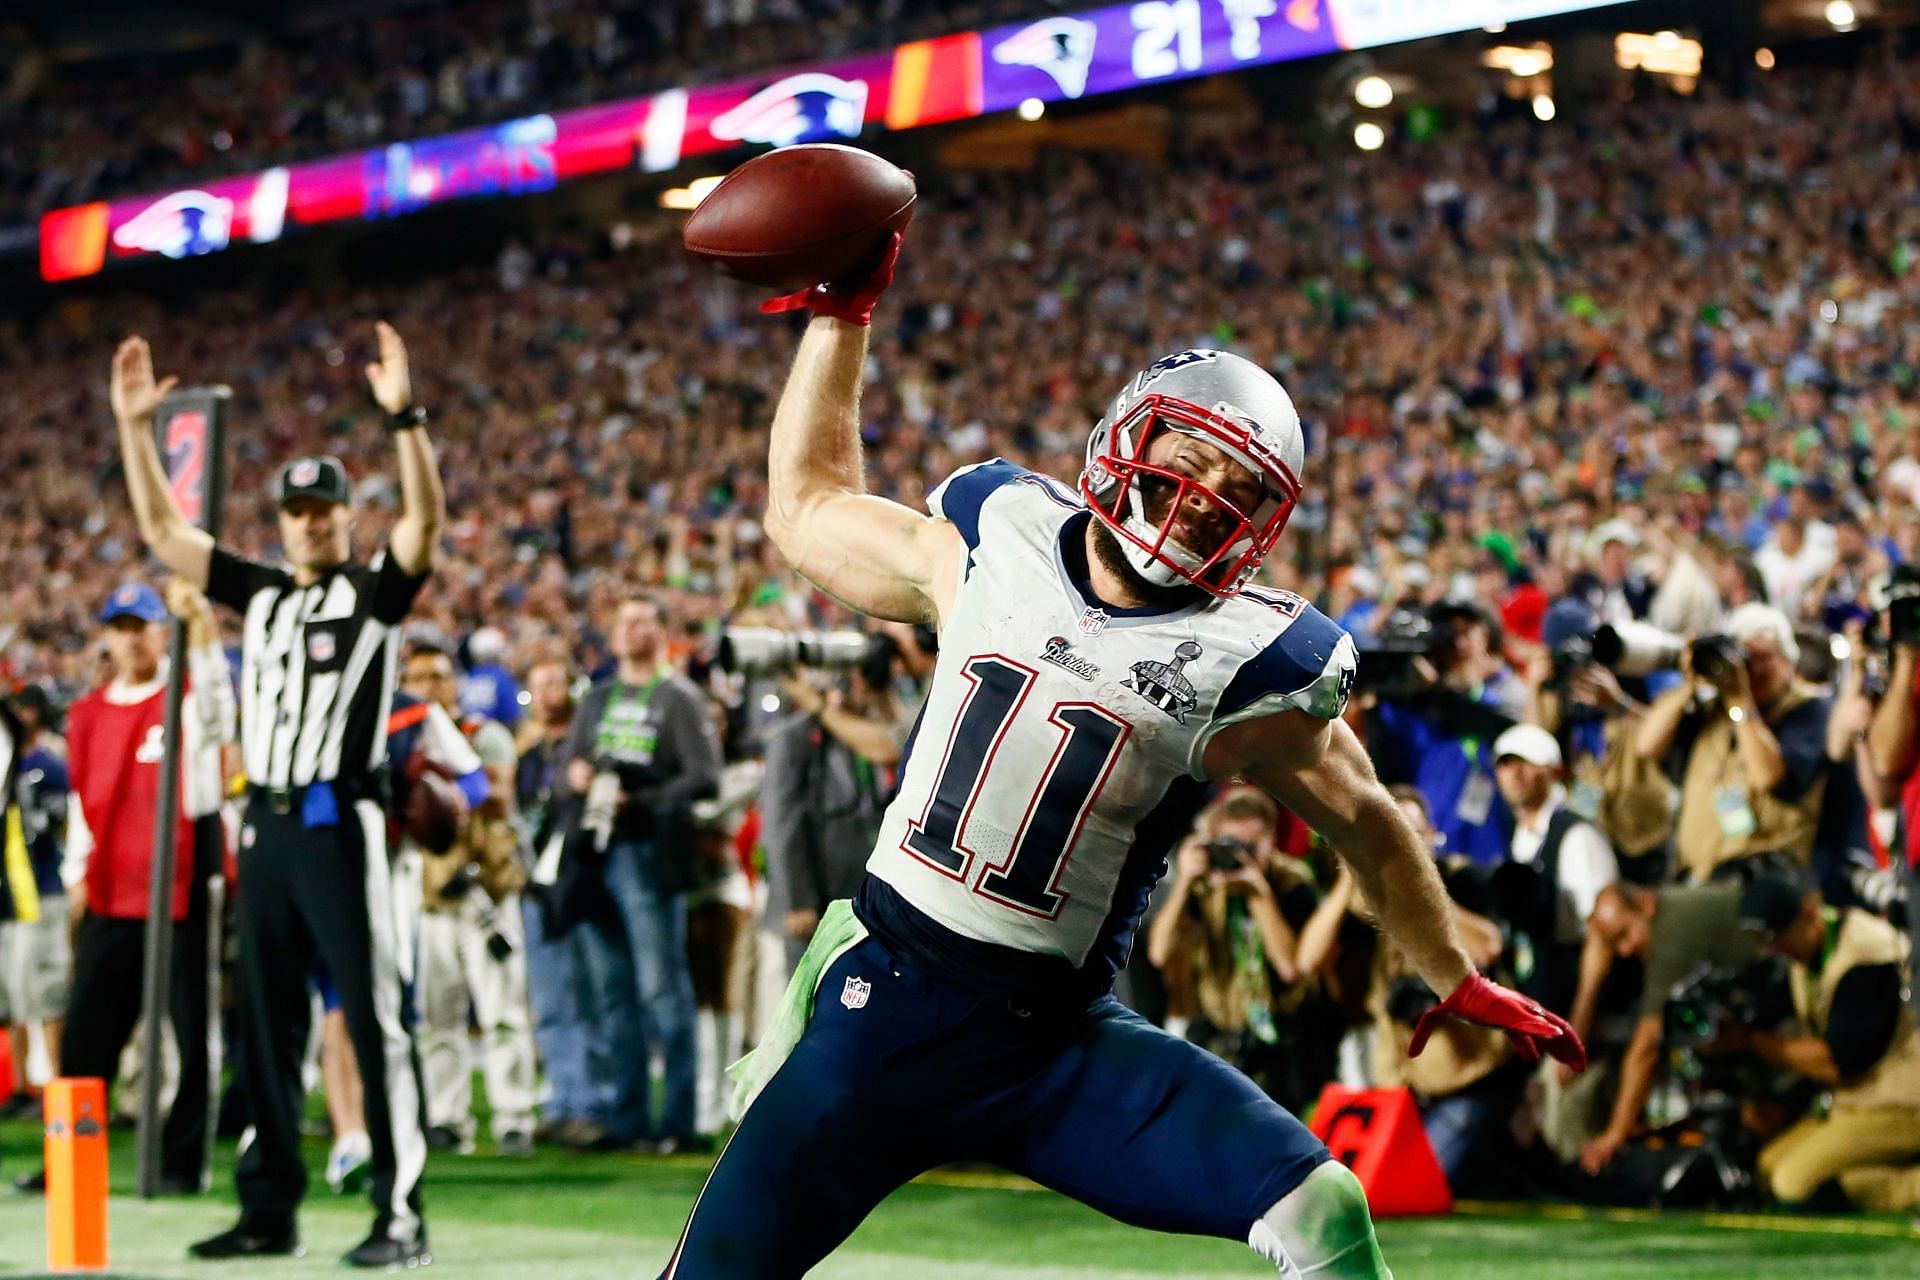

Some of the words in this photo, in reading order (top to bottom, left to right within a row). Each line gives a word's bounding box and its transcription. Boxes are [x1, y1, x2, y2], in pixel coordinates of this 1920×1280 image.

[1129, 0, 1201, 79] 21
[166, 410, 207, 522] 2
[1039, 643, 1099, 682] Patriots
[1080, 618, 1099, 635] NFL
[900, 653, 1134, 922] 11
